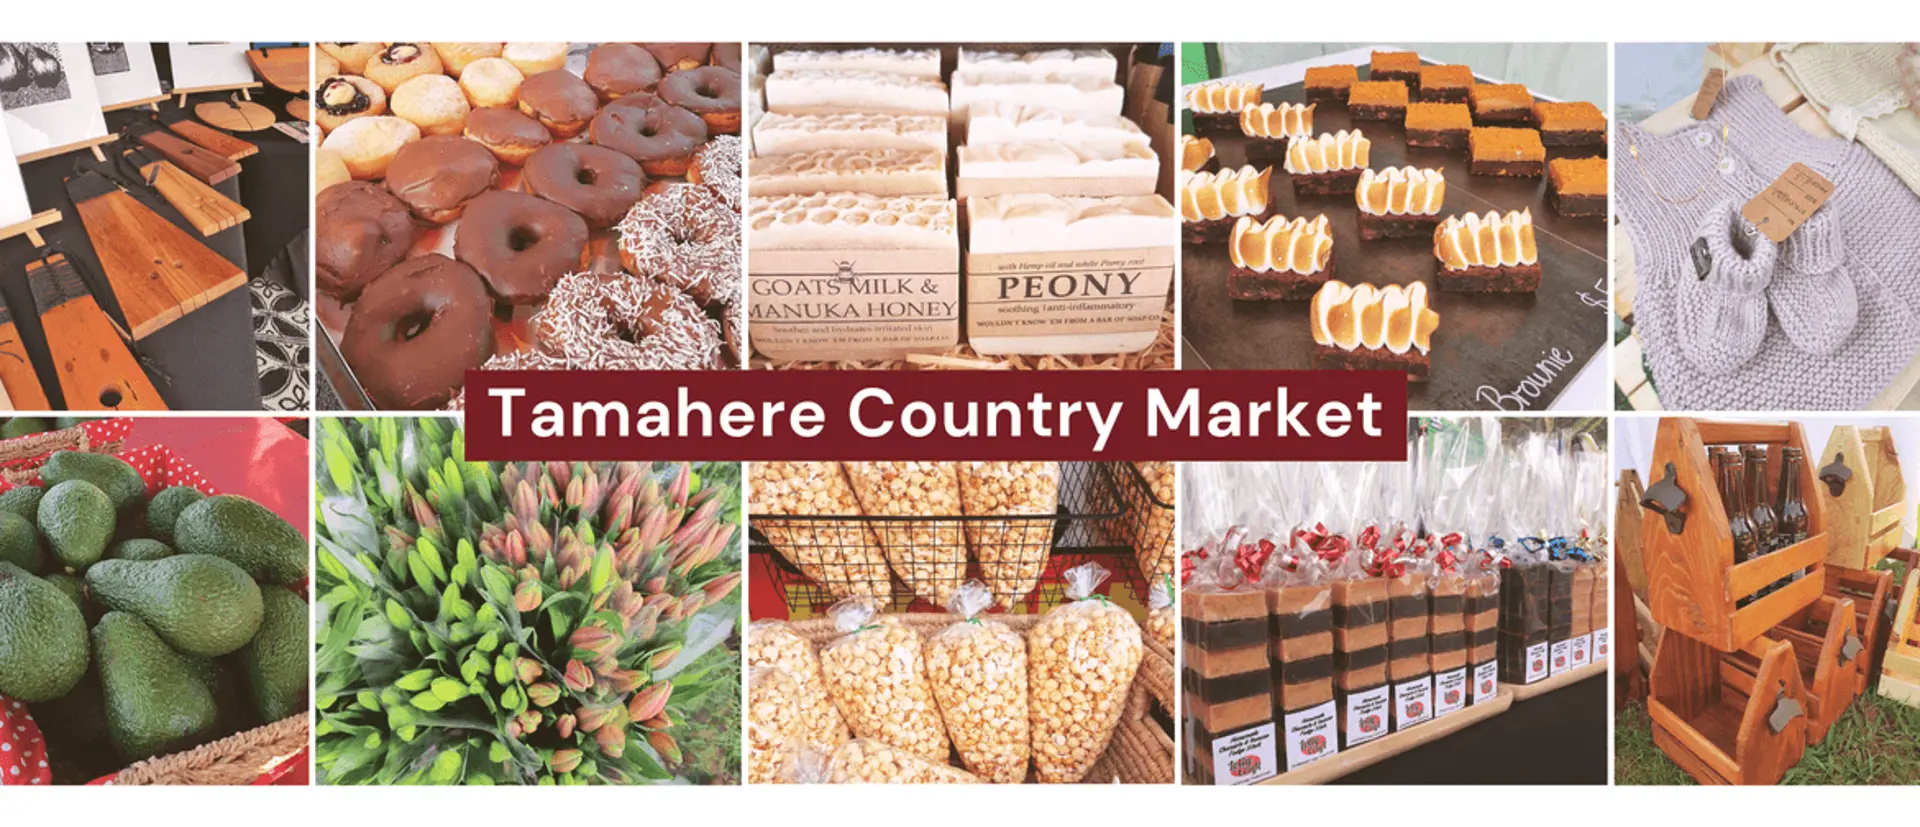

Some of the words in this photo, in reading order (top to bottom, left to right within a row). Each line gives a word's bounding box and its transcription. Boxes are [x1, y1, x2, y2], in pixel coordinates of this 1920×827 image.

[998, 263, 1016, 271] with
[1019, 262, 1043, 271] Hemp
[752, 279, 841, 296] GOATS
[848, 278, 913, 295] MILK
[920, 278, 939, 294] &
[997, 272, 1142, 299] PEONY
[868, 301, 957, 317] HONEY
[998, 304, 1040, 314] soothing
[914, 323, 934, 332] skin
[1064, 317, 1087, 325] FROM
[1476, 347, 1574, 411] Brownie
